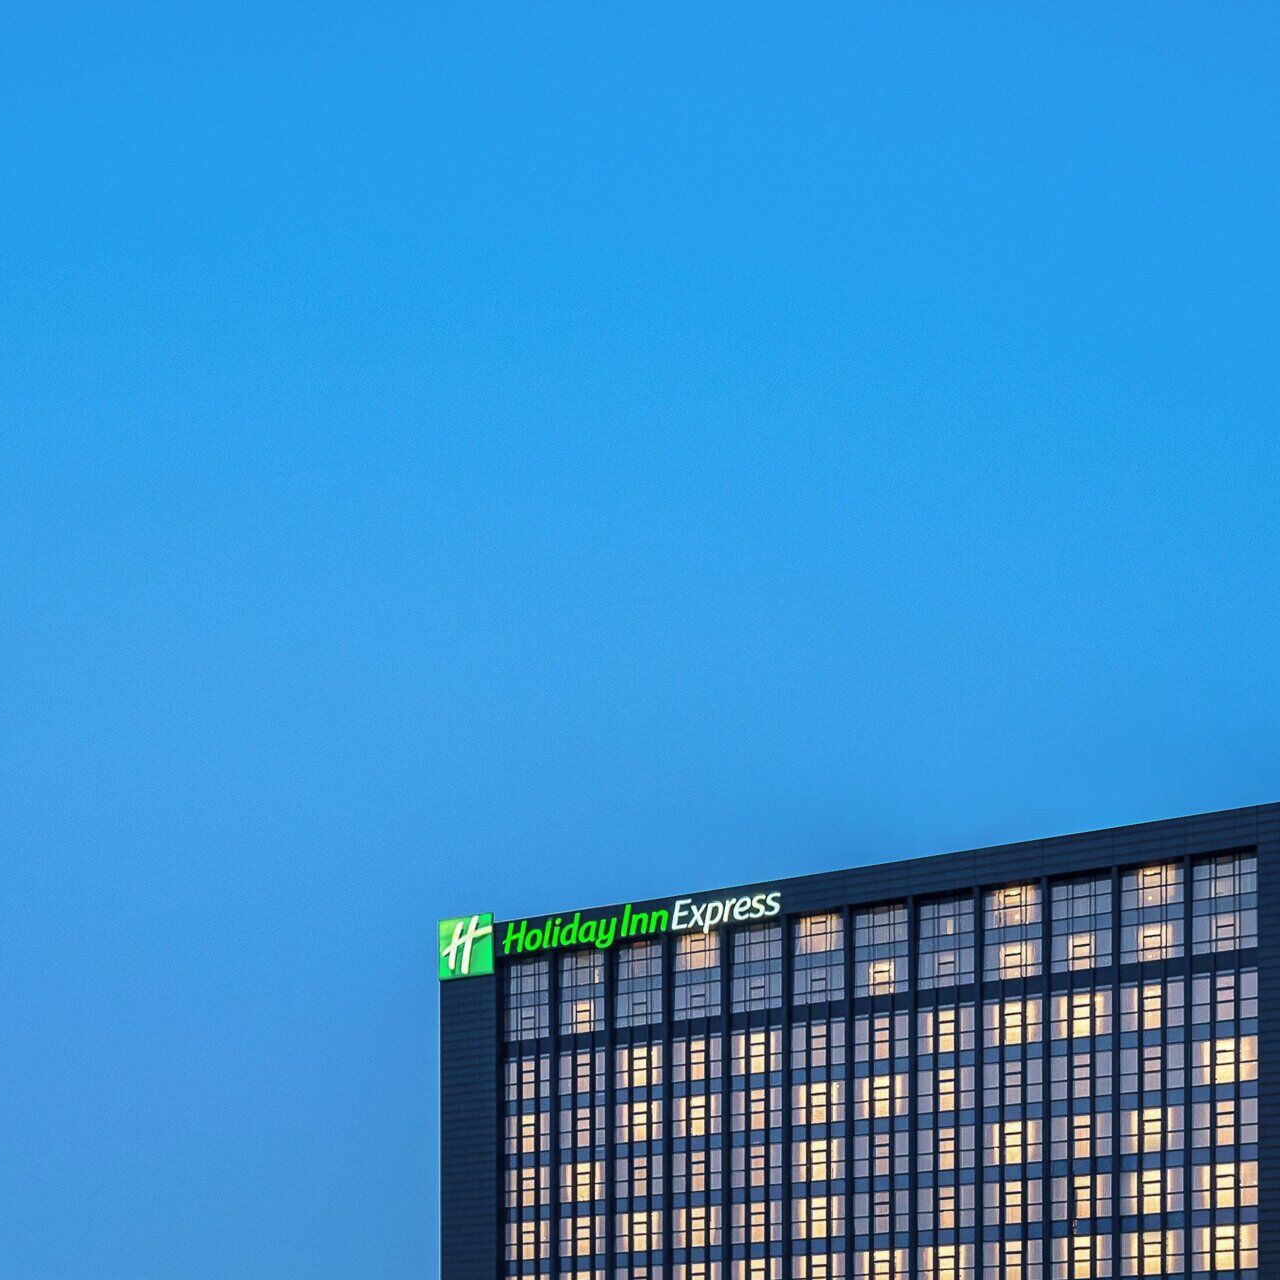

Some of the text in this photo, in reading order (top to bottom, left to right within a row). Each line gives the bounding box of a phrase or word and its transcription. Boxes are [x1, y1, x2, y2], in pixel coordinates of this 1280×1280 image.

[503, 890, 782, 955] Holiday Inn Express
